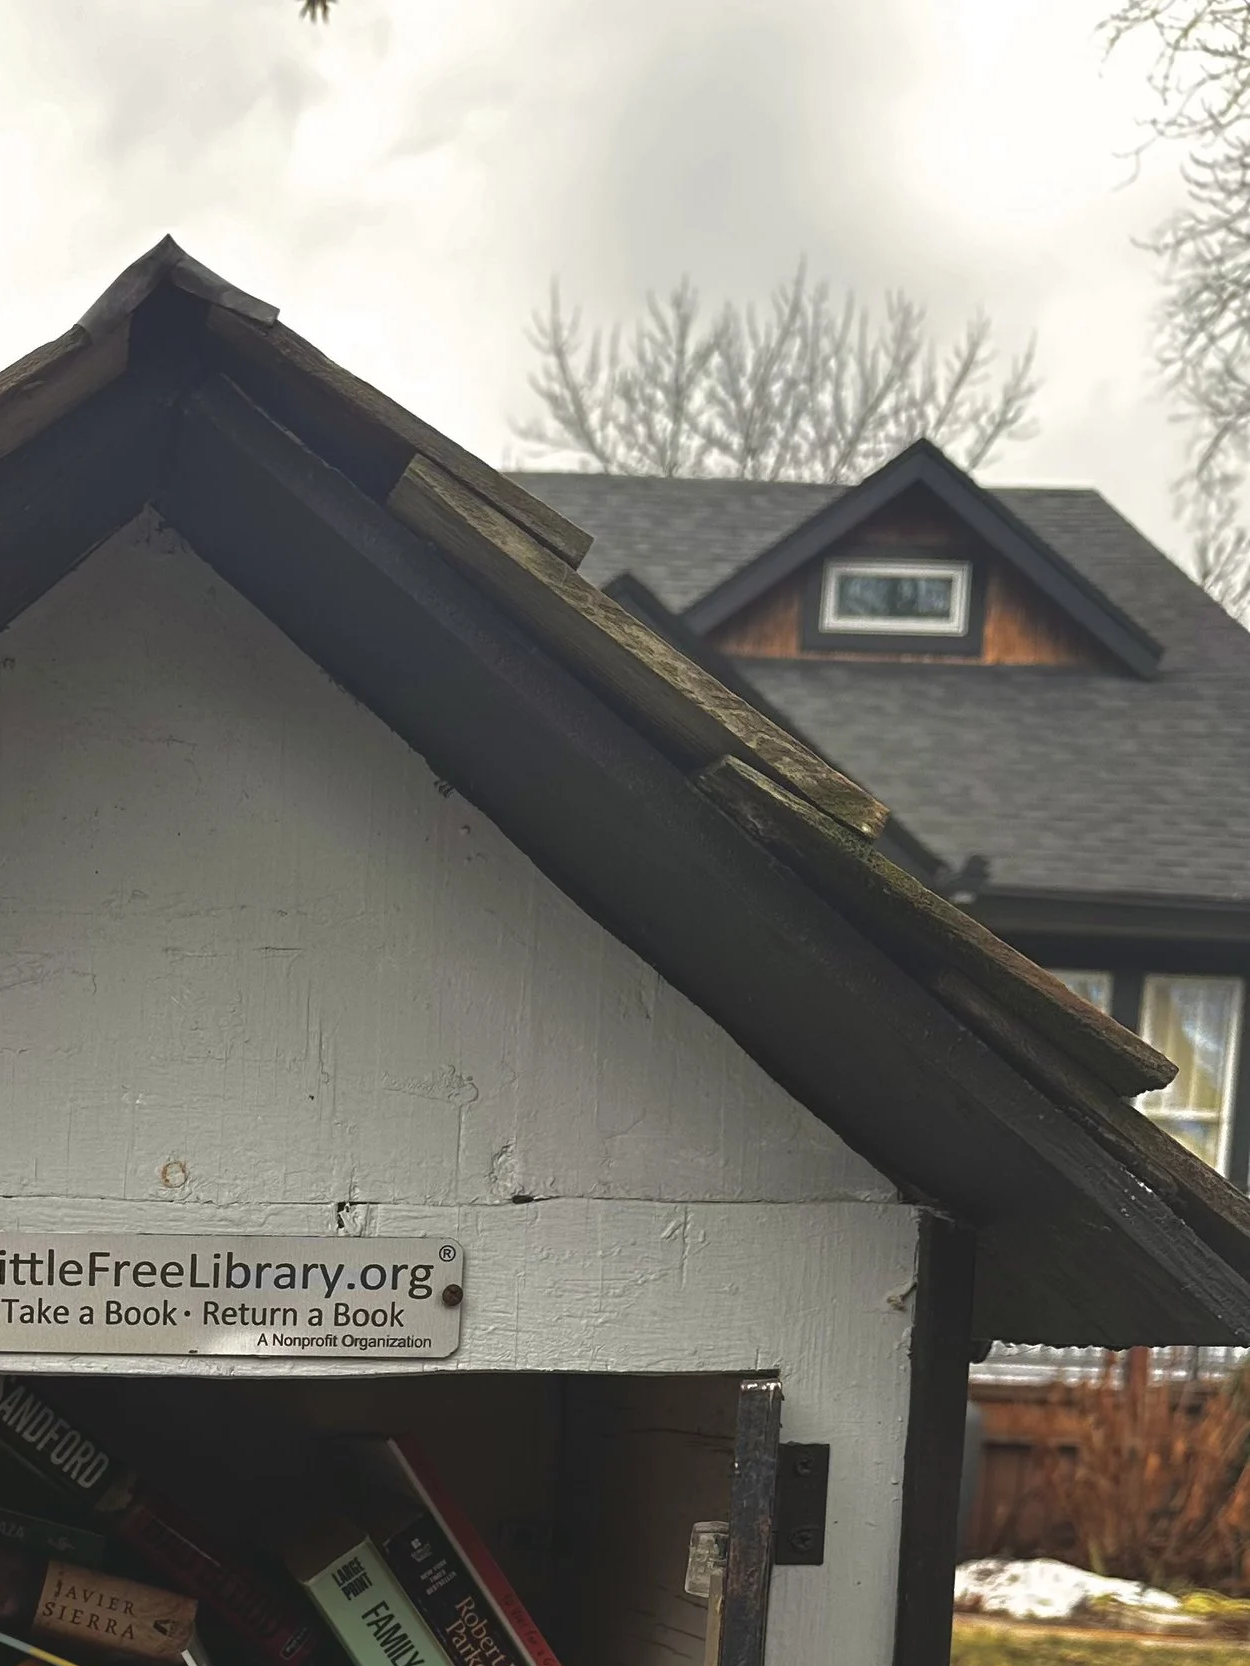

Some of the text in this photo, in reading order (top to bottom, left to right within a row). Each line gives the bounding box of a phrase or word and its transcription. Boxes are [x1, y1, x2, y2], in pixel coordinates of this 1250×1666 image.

[0, 1297, 405, 1328] Take a Book Return a Book
[256, 1332, 432, 1349] A Nonprofit Organization
[330, 1555, 364, 1587] LARGE
[340, 1570, 374, 1601] PRINT
[53, 1579, 137, 1617] JAVIER
[41, 1600, 136, 1641] SIERRA
[454, 1595, 507, 1665] Robert
